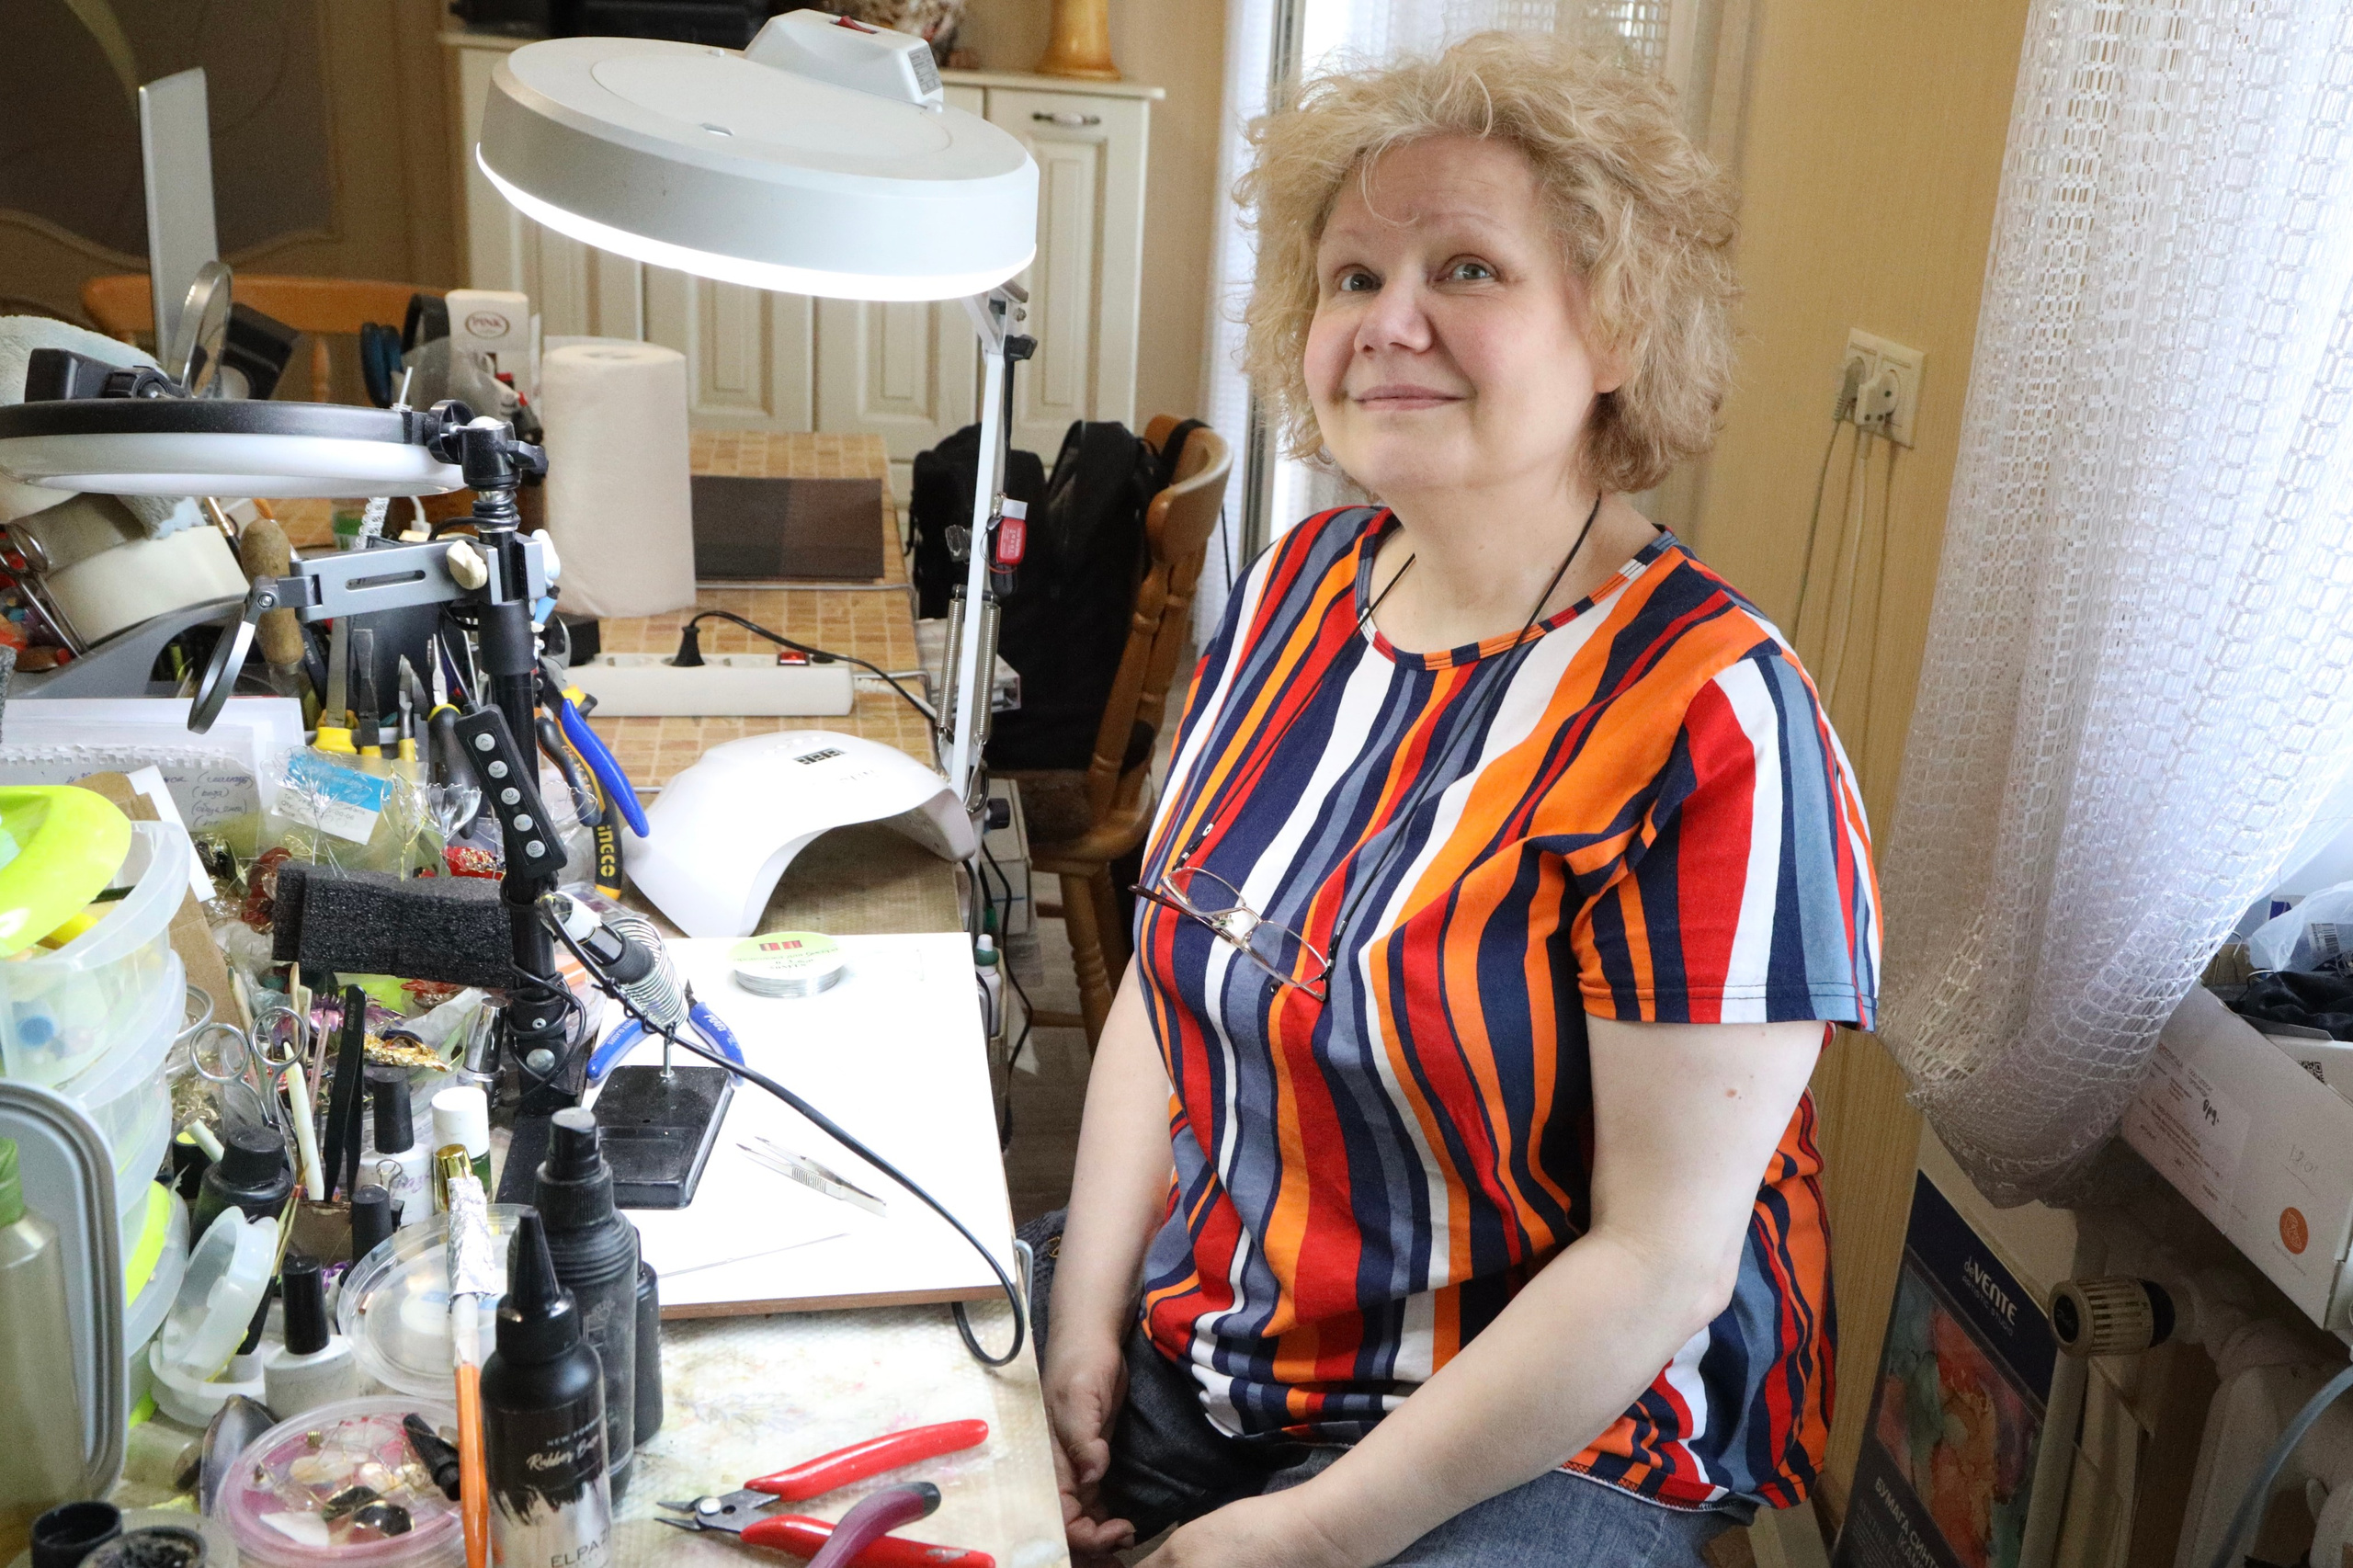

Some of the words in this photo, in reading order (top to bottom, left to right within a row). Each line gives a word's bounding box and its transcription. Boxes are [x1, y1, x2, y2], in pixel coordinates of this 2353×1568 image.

[1963, 1256, 2018, 1326] deVENTE
[551, 1528, 609, 1568] ELPAZ
[1875, 1476, 1909, 1535] БУМАГА
[1910, 1530, 1939, 1568] СИНТ
